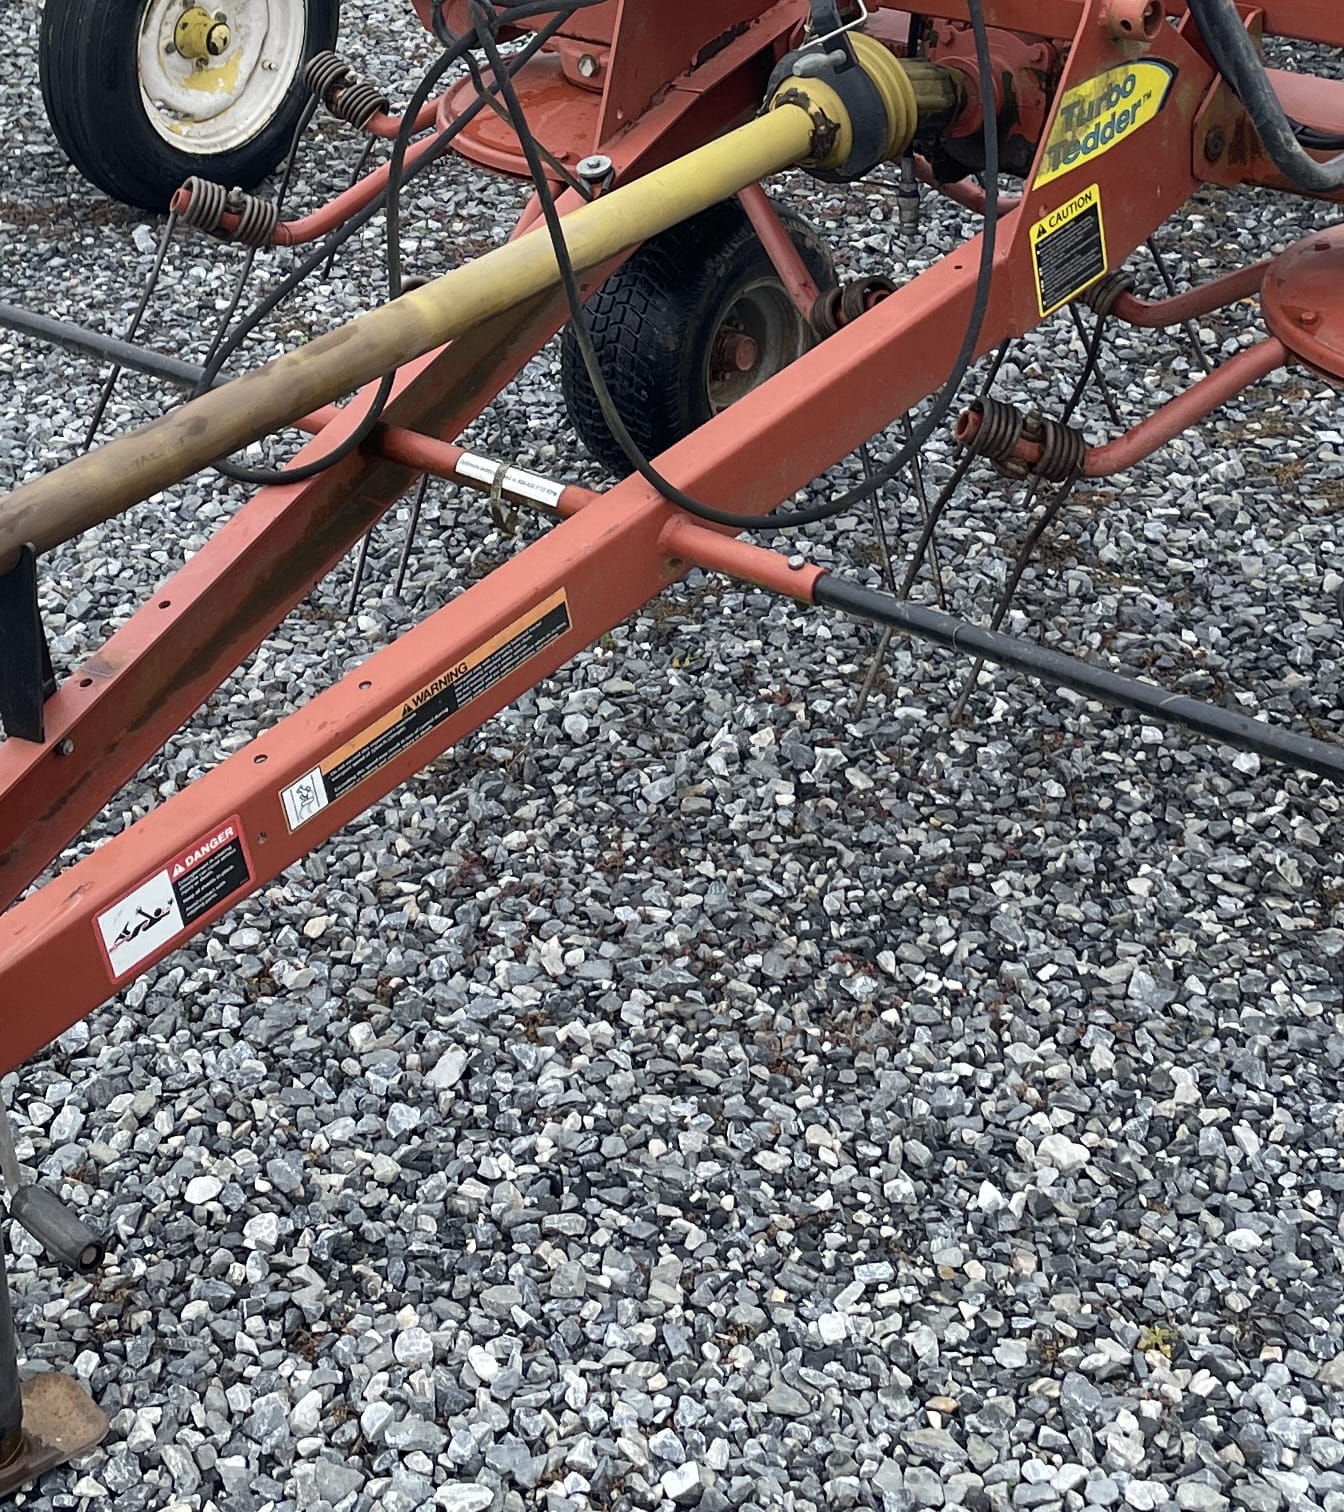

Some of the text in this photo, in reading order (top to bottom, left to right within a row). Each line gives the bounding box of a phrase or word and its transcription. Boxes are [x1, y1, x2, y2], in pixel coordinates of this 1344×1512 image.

[1060, 73, 1136, 131] Turbo
[1048, 191, 1093, 228] CAUTION
[411, 661, 468, 707] WARNING
[184, 826, 234, 867] DANGER
